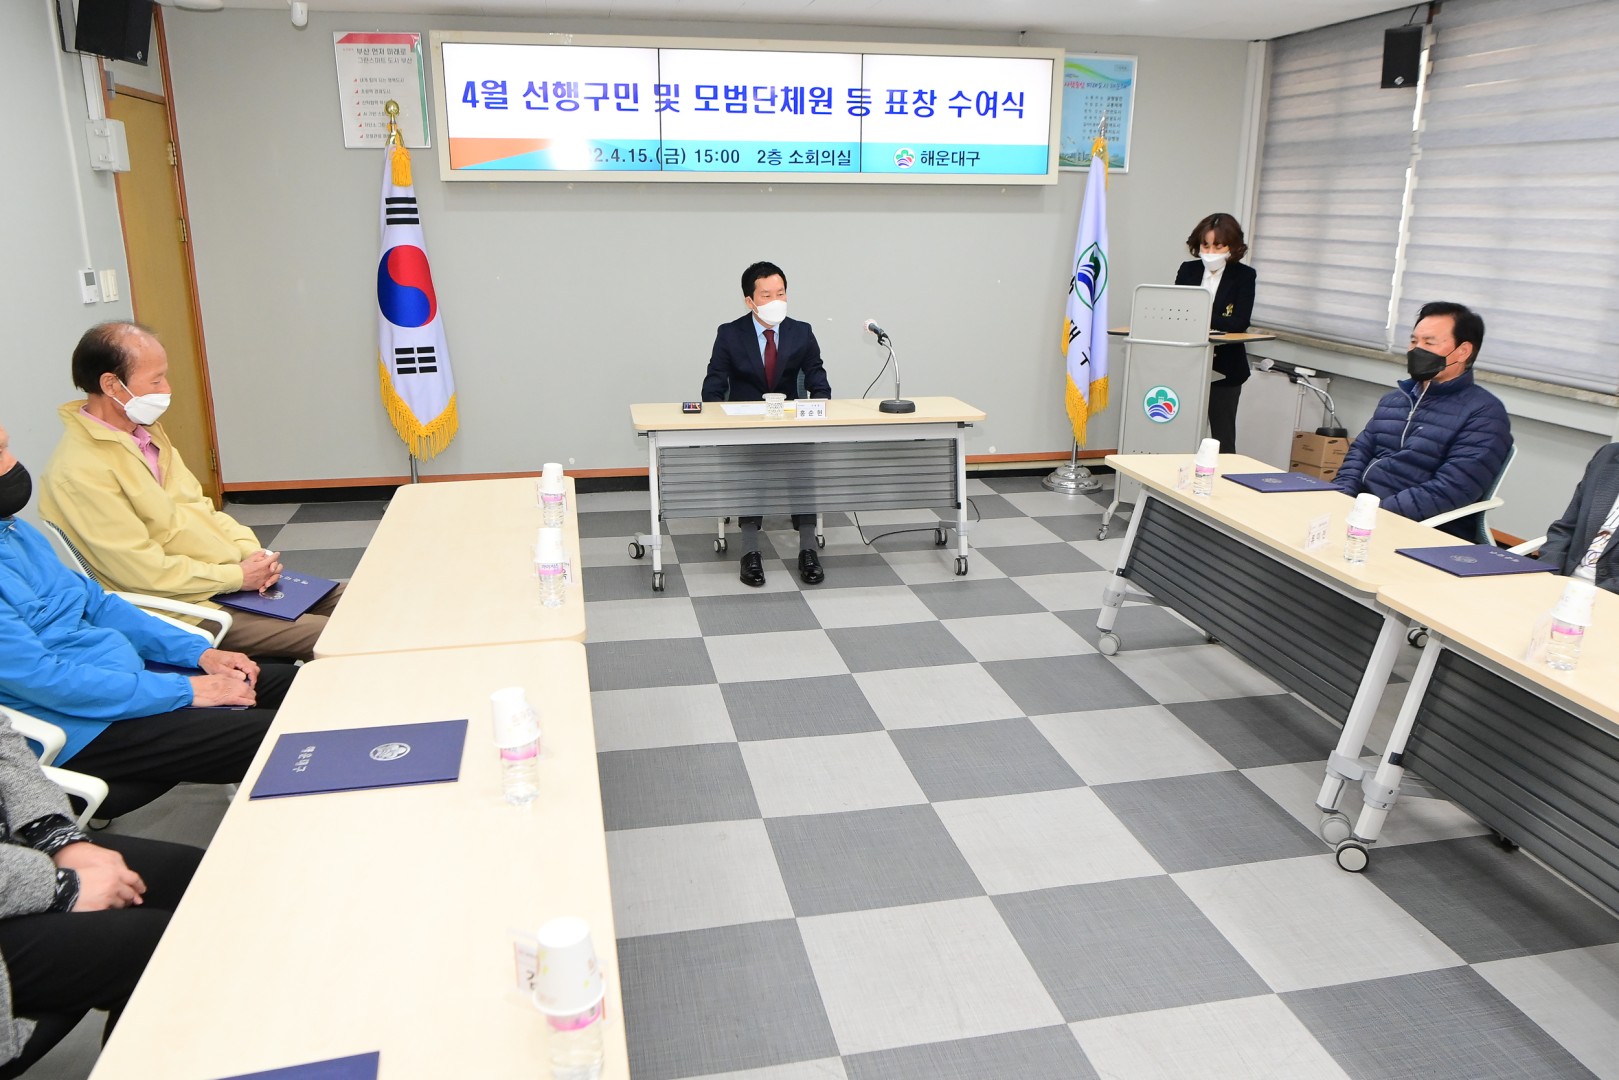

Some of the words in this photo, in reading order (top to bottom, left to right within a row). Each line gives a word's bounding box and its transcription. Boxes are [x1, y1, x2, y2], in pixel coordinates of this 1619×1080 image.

[357, 48, 369, 56] 부산
[387, 48, 407, 56] 미래로
[462, 79, 508, 109] 4월
[522, 80, 639, 112] 선행구민
[653, 83, 680, 113] 및
[694, 84, 833, 115] 모범단체원
[846, 87, 872, 117] 등
[884, 88, 937, 118] 표창
[948, 90, 1025, 119] 수여식
[588, 147, 686, 165] 2.4.15.(금)
[694, 149, 740, 164] 15:00
[756, 149, 782, 165] 2층
[788, 149, 852, 166] 소회의실
[920, 150, 981, 167] 해운대구
